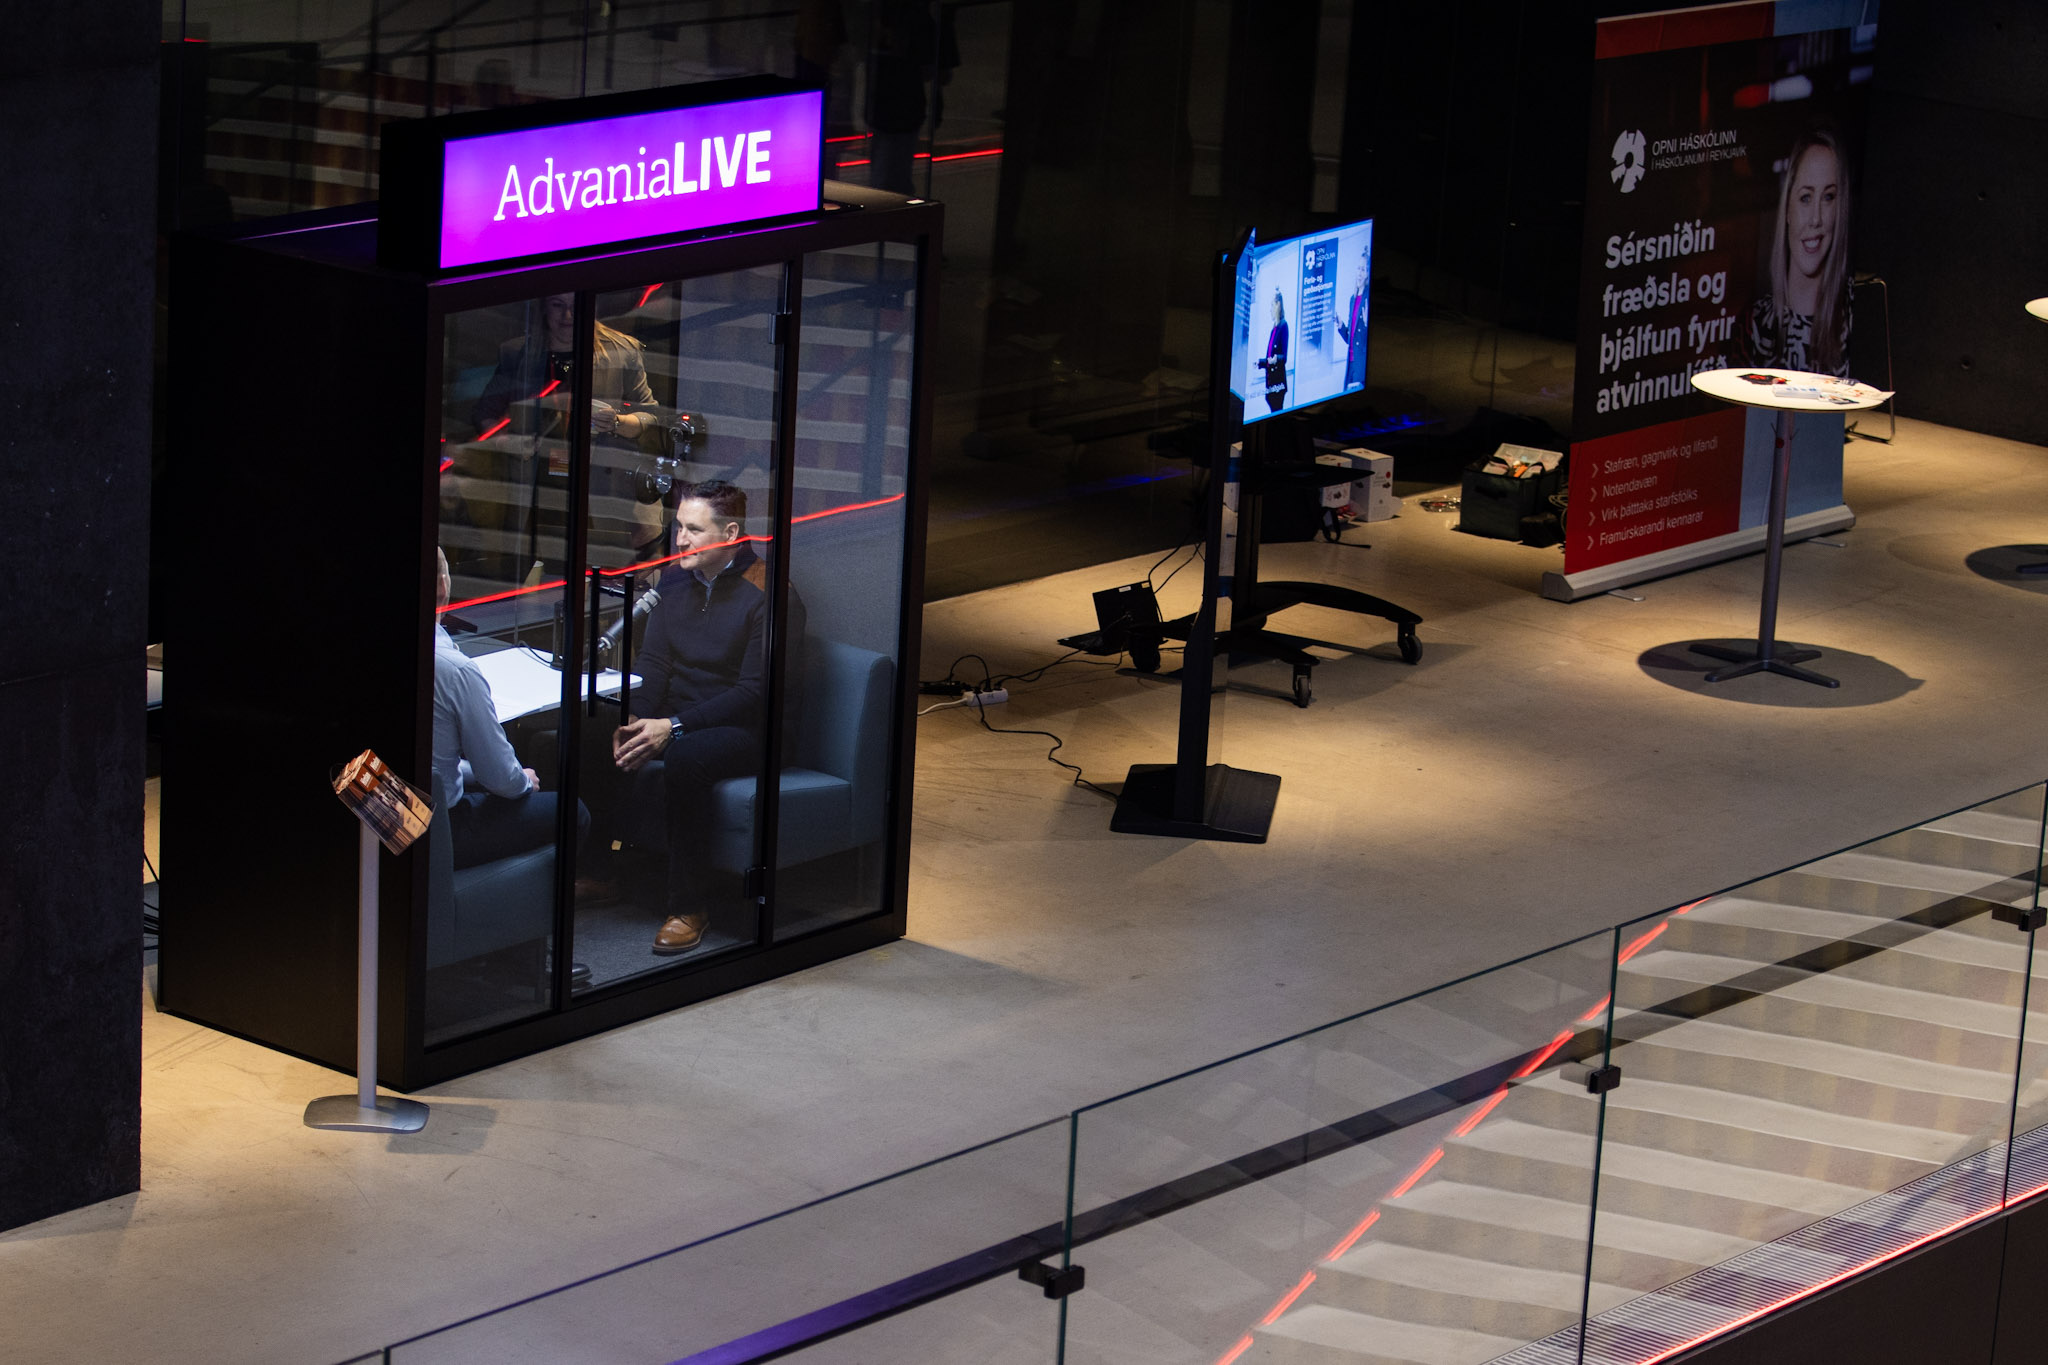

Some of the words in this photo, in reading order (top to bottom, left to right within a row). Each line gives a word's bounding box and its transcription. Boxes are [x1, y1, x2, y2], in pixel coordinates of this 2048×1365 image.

[1652, 140, 1677, 156] OPNI
[1679, 129, 1737, 151] HÁSKÓLINN
[1655, 153, 1705, 170] HÁSKÓLANUM
[1709, 145, 1747, 162] REYKJAVÍK
[493, 129, 772, 222] AdvaniaLIVE
[1605, 218, 1715, 269] Sérsniðin
[1603, 272, 1691, 317] fræðsla
[1697, 271, 1727, 304] og
[1599, 323, 1681, 374] þjálfun
[1688, 307, 1736, 354] fyrir
[1604, 456, 1640, 474] Stafræn,
[1641, 445, 1679, 468] gagnvirk
[1680, 444, 1692, 458] og
[1693, 436, 1718, 451] lifandi
[1602, 475, 1658, 498] Notendavæn
[1601, 507, 1618, 522] Virk
[1655, 488, 1698, 509] starfsfólks
[1600, 518, 1665, 546] Framúrskarandi
[1667, 511, 1704, 529] kennarar
